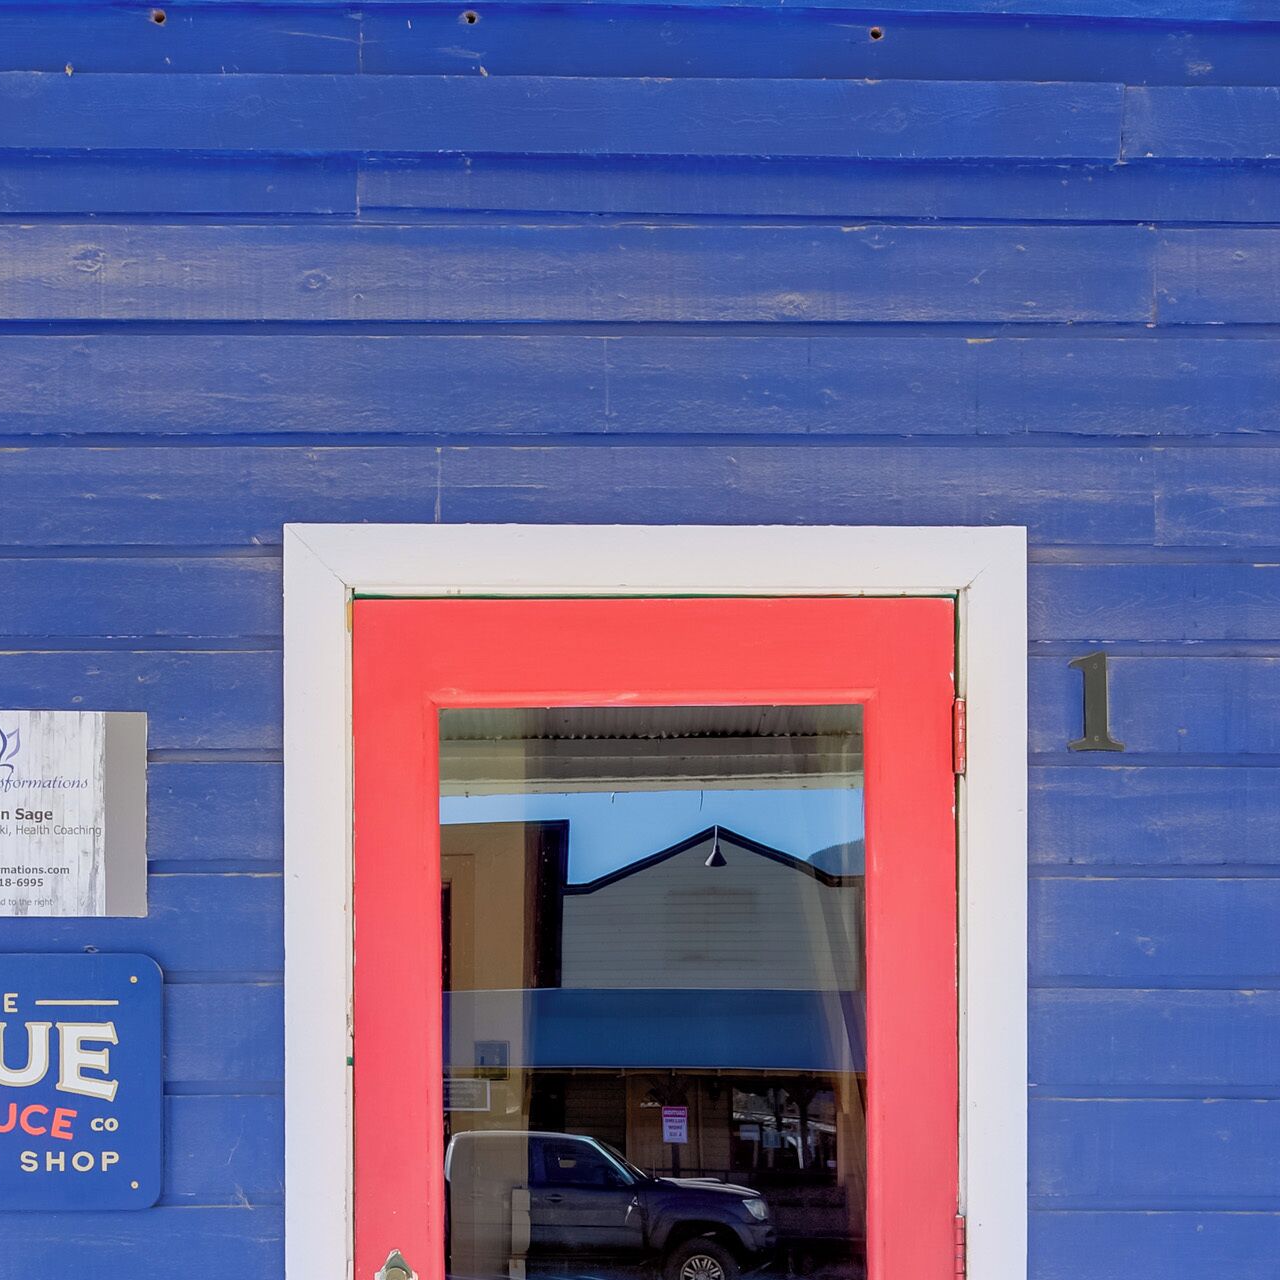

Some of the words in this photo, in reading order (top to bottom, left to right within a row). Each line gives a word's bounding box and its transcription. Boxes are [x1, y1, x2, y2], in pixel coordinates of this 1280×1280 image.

[1067, 651, 1125, 752] 1
[15, 807, 53, 823] Sage
[15, 824, 50, 836] Health
[53, 824, 102, 838] Coaching
[8, 898, 17, 906] to
[19, 898, 32, 906] the
[34, 896, 55, 908] right
[90, 1117, 119, 1132] CO
[20, 1151, 119, 1172] SHOP
